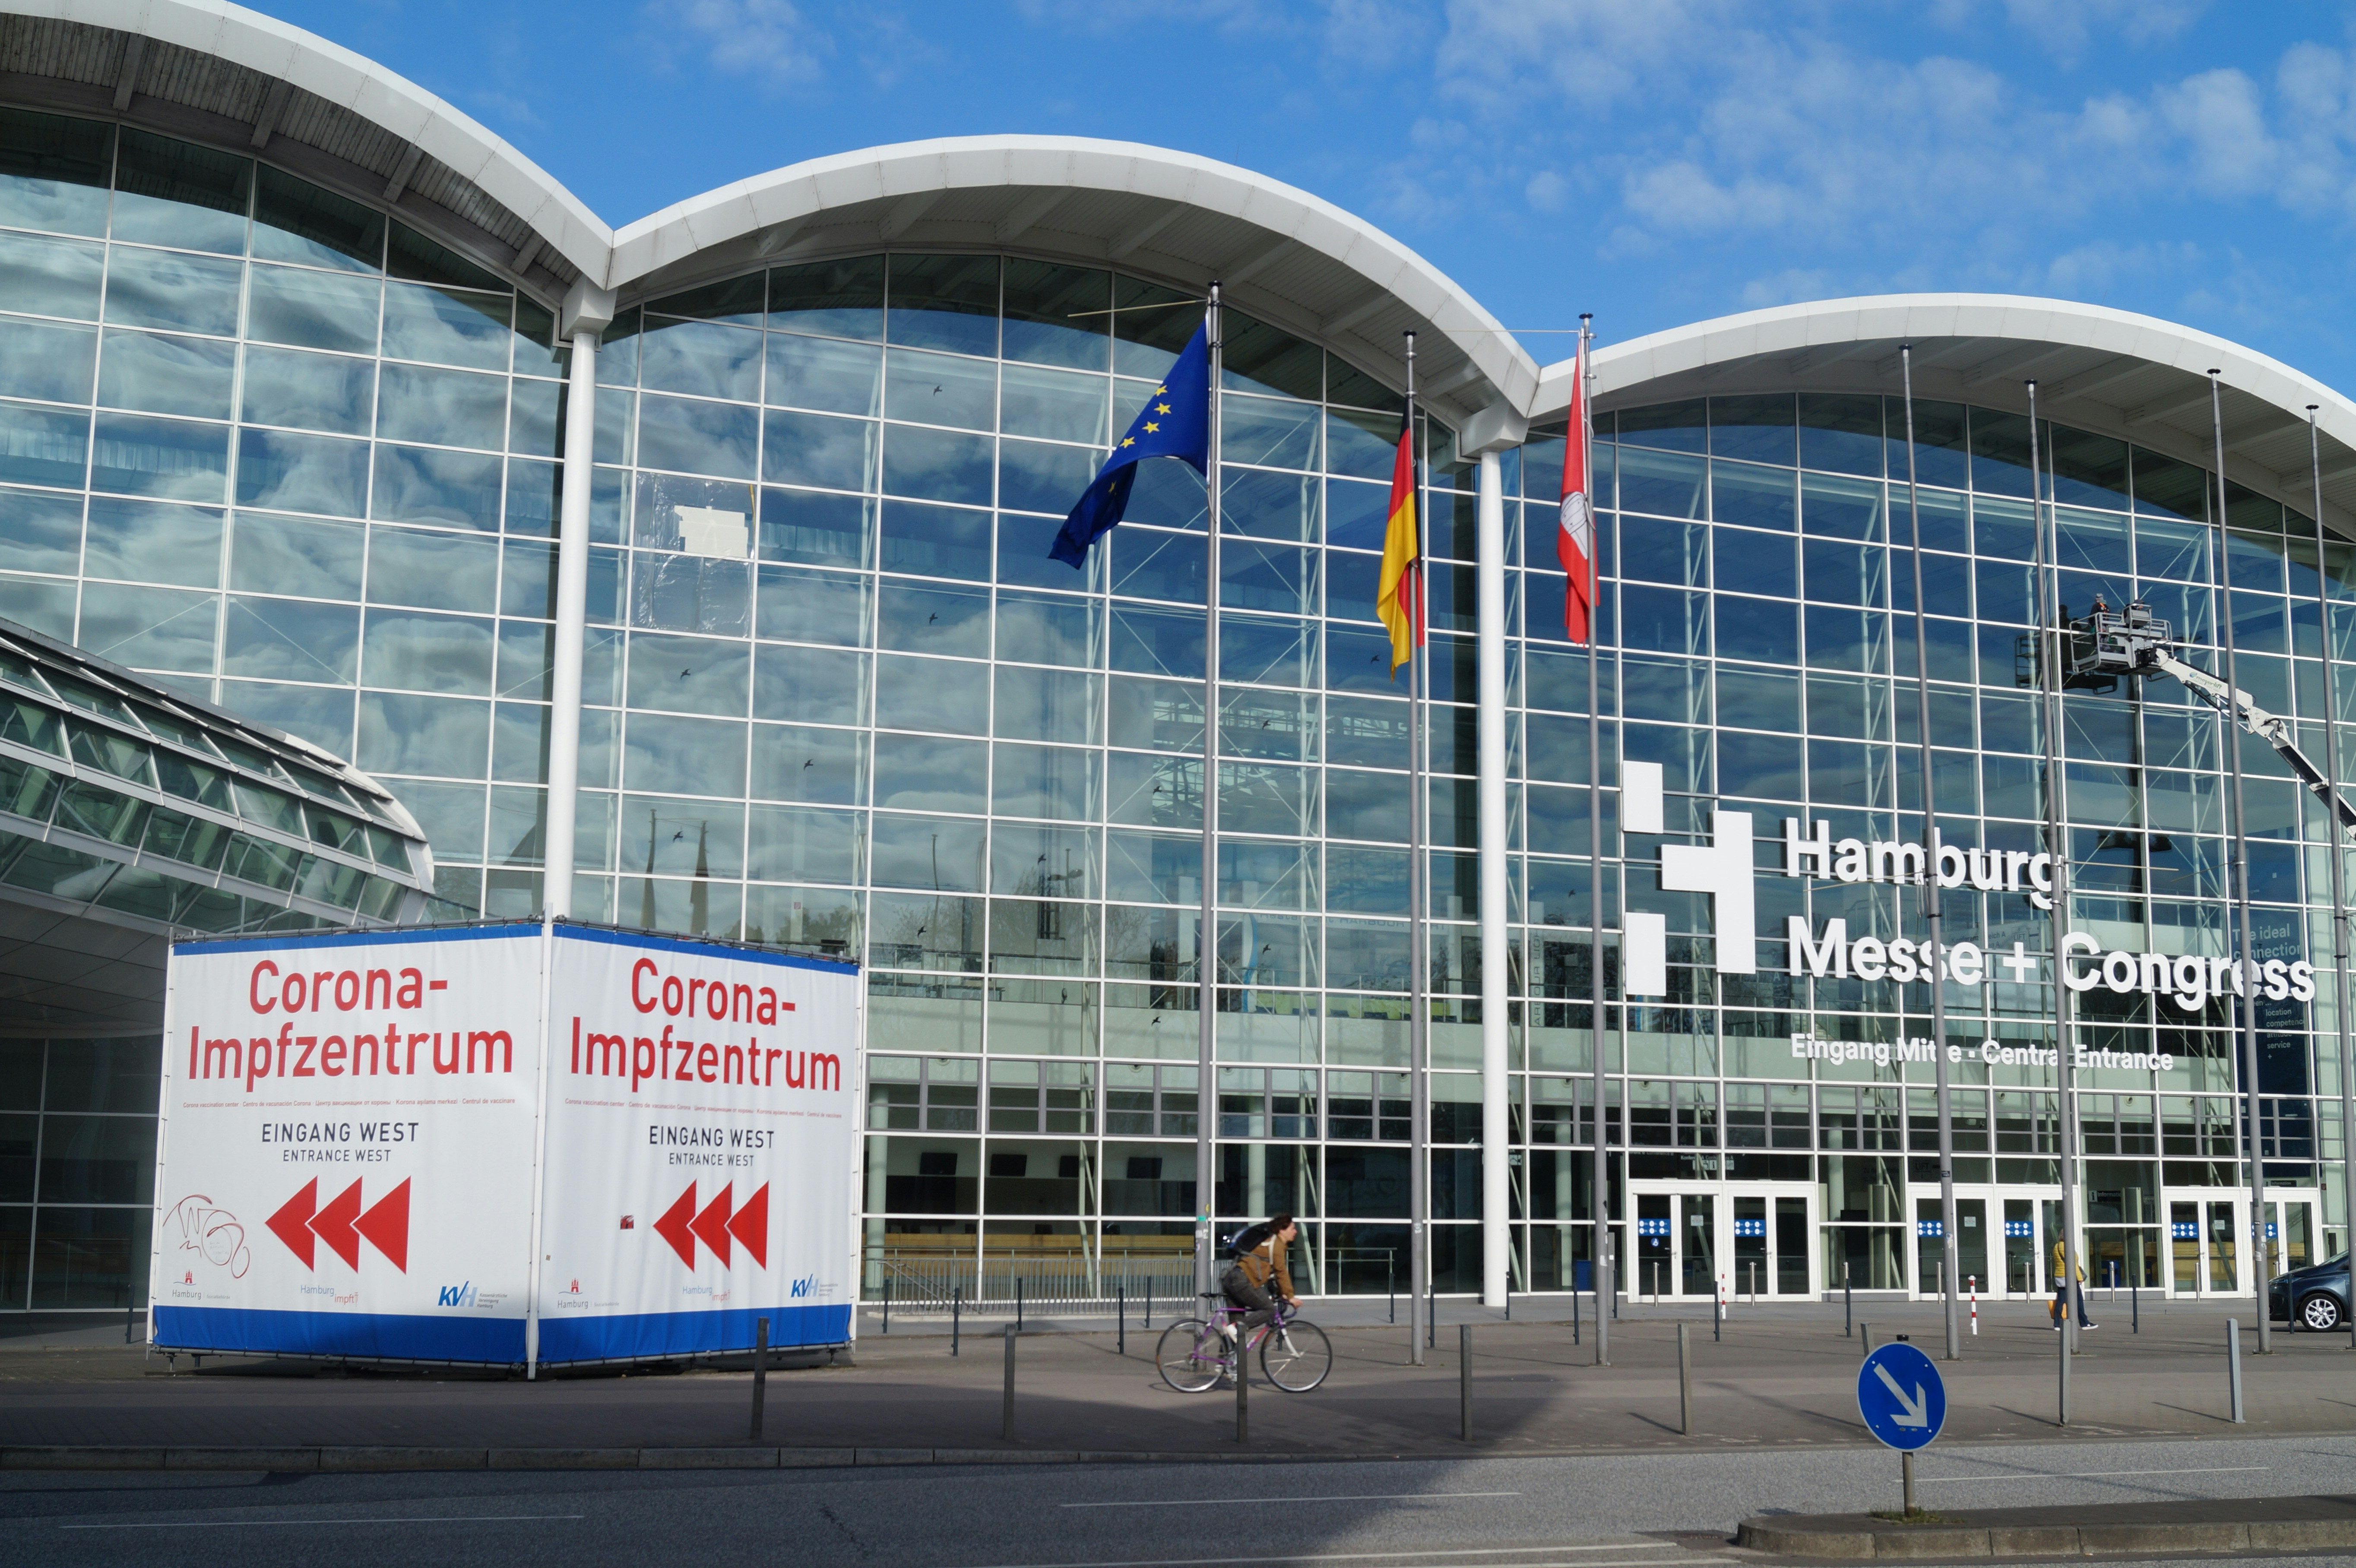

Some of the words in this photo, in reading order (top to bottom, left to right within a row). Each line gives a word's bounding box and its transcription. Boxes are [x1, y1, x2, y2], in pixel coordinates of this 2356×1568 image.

[1786, 817, 2062, 910] Hamburg
[2232, 928, 2256, 942] Te
[2259, 923, 2290, 939] ideal
[1789, 916, 1982, 985] Messe
[2062, 932, 2315, 1011] Congress
[250, 960, 448, 1015] Corona-
[631, 958, 796, 1026] Corona-
[2266, 1008, 2292, 1016] location
[189, 1021, 513, 1093] Impfzentrum
[571, 1017, 840, 1093] Impfzentrum
[1791, 1033, 1889, 1067] Eingang
[1897, 1037, 1962, 1063] Mite
[1982, 1040, 2058, 1064] Centra
[2074, 1044, 2173, 1070] Entrance
[262, 1123, 350, 1142] EINGANG
[360, 1122, 419, 1142] WEST
[649, 1125, 723, 1147] EINGANG
[730, 1129, 774, 1149] WEST
[283, 1150, 350, 1162] ENTRANCE
[355, 1150, 391, 1162] WEST
[669, 1152, 723, 1165] ENTRANCE
[727, 1154, 754, 1166] WEST
[172, 1289, 202, 1300] Hamburg
[301, 1285, 334, 1296] Hamburg
[438, 1280, 478, 1307] KVH
[682, 1285, 712, 1296] Hamburg
[791, 1274, 819, 1297] KVH
[557, 1299, 589, 1309] Hamburg
